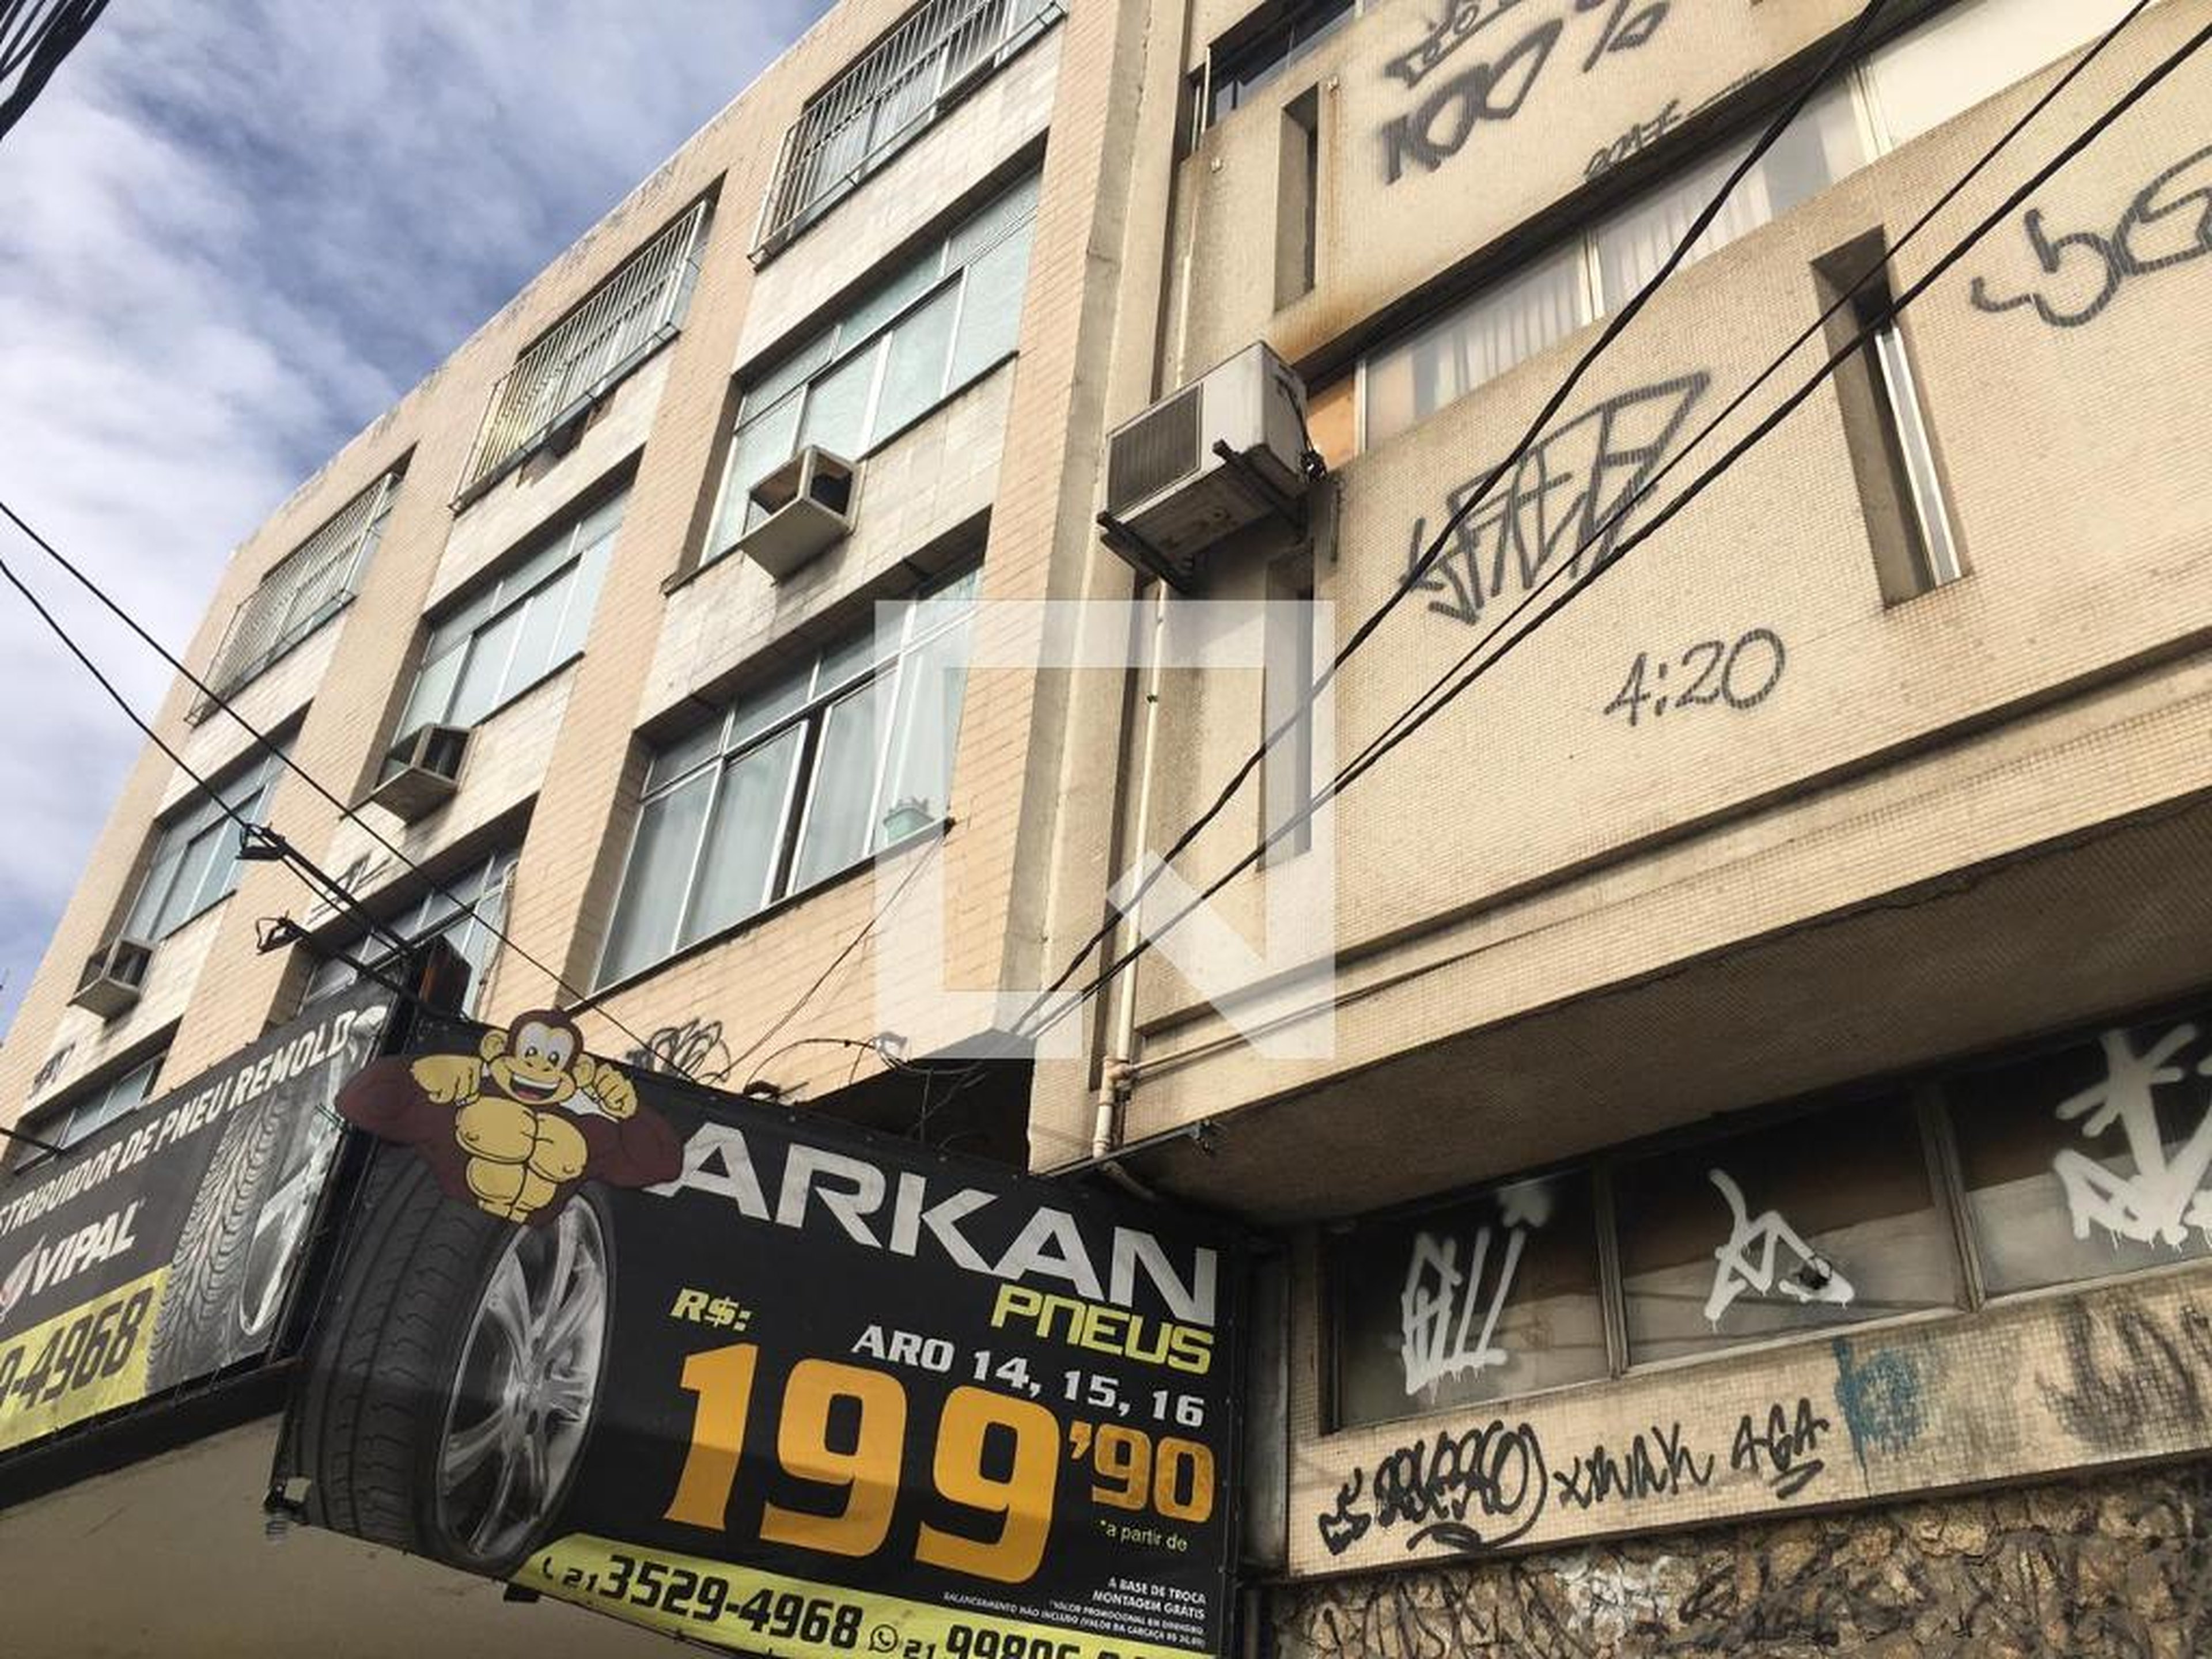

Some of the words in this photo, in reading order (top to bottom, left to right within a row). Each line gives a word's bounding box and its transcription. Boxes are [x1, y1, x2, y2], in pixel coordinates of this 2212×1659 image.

[1604, 628, 1786, 726] 4:20
[117, 1119, 160, 1173] DE
[154, 1077, 232, 1152] PNEU
[31, 1200, 139, 1296] VIPAL
[642, 1122, 1217, 1327] ARKAN
[669, 1288, 753, 1332] R$:
[851, 1324, 954, 1373] ARO
[972, 1349, 1042, 1399] 14,
[1062, 1370, 1131, 1418] 15,
[1152, 1391, 1205, 1427] 16
[1120, 1527, 1161, 1546] partir
[1166, 1533, 1187, 1552] de
[599, 1554, 863, 1649] 3529-4968
[1092, 1590, 1161, 1612] MONTAGEM
[1120, 1578, 1147, 1595] BASE
[1151, 1584, 1165, 1597] DE
[1168, 1588, 1206, 1605] TROCA
